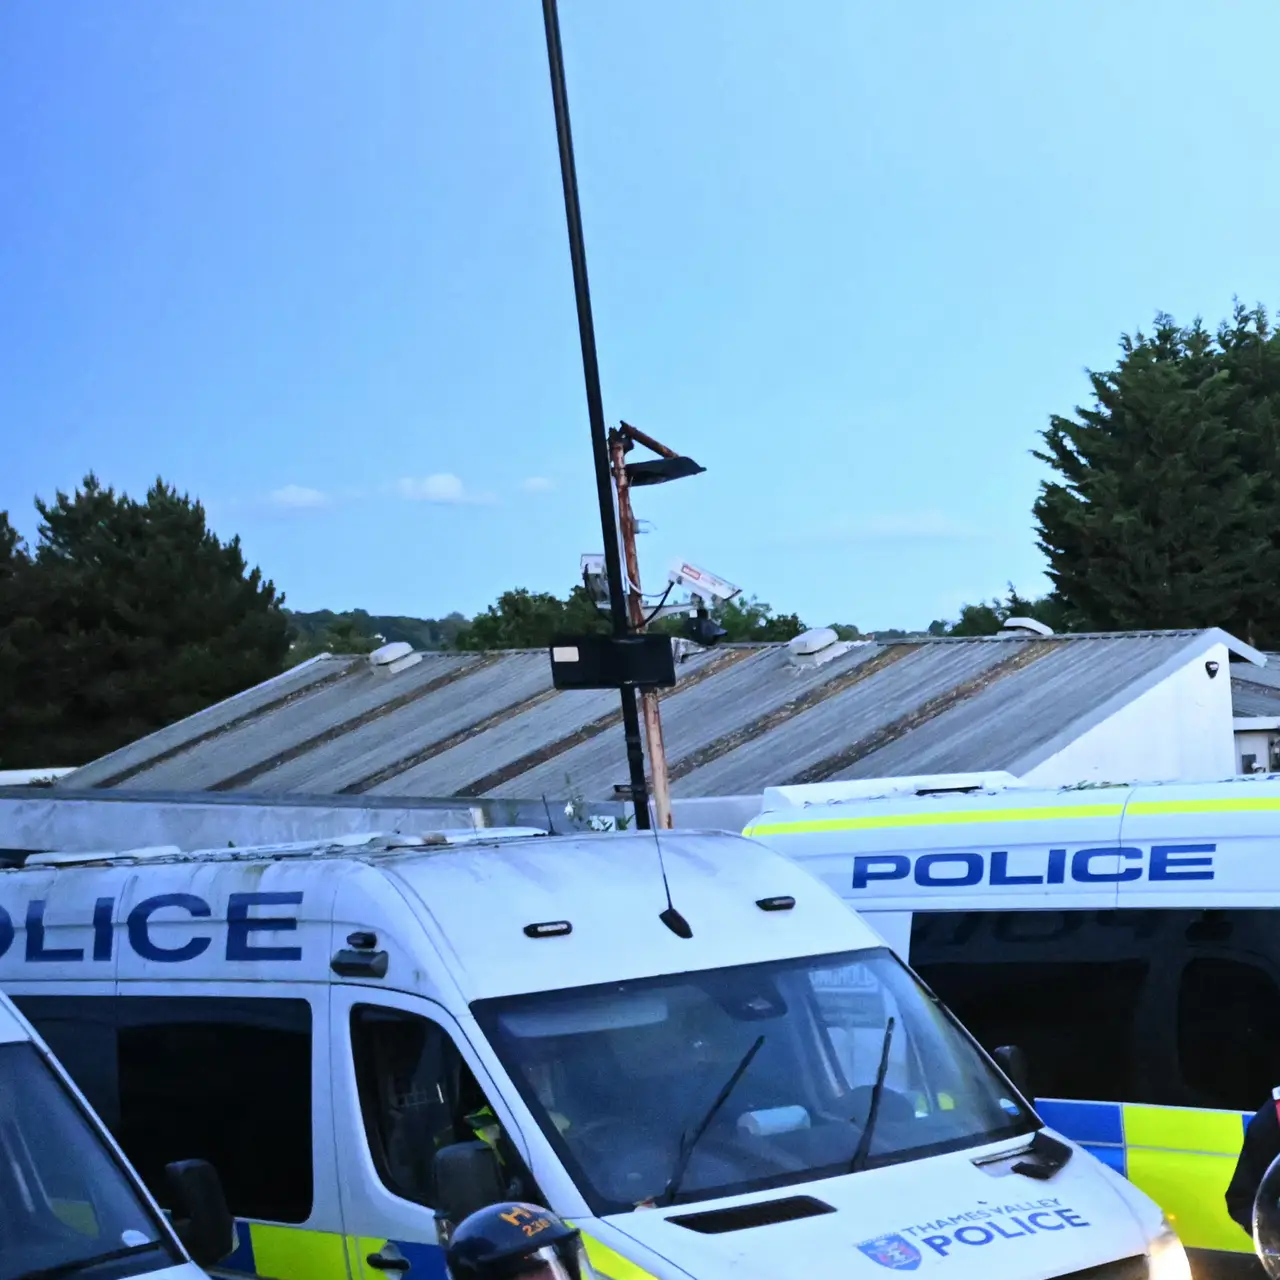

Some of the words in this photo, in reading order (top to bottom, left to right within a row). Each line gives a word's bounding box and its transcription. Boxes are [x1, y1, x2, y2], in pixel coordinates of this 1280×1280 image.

[852, 843, 1217, 889] POLICE
[0, 891, 304, 963] LICE
[902, 1209, 991, 1237] THAMES
[989, 1197, 1063, 1216] VALLEY
[921, 1208, 1091, 1257] POLICE
